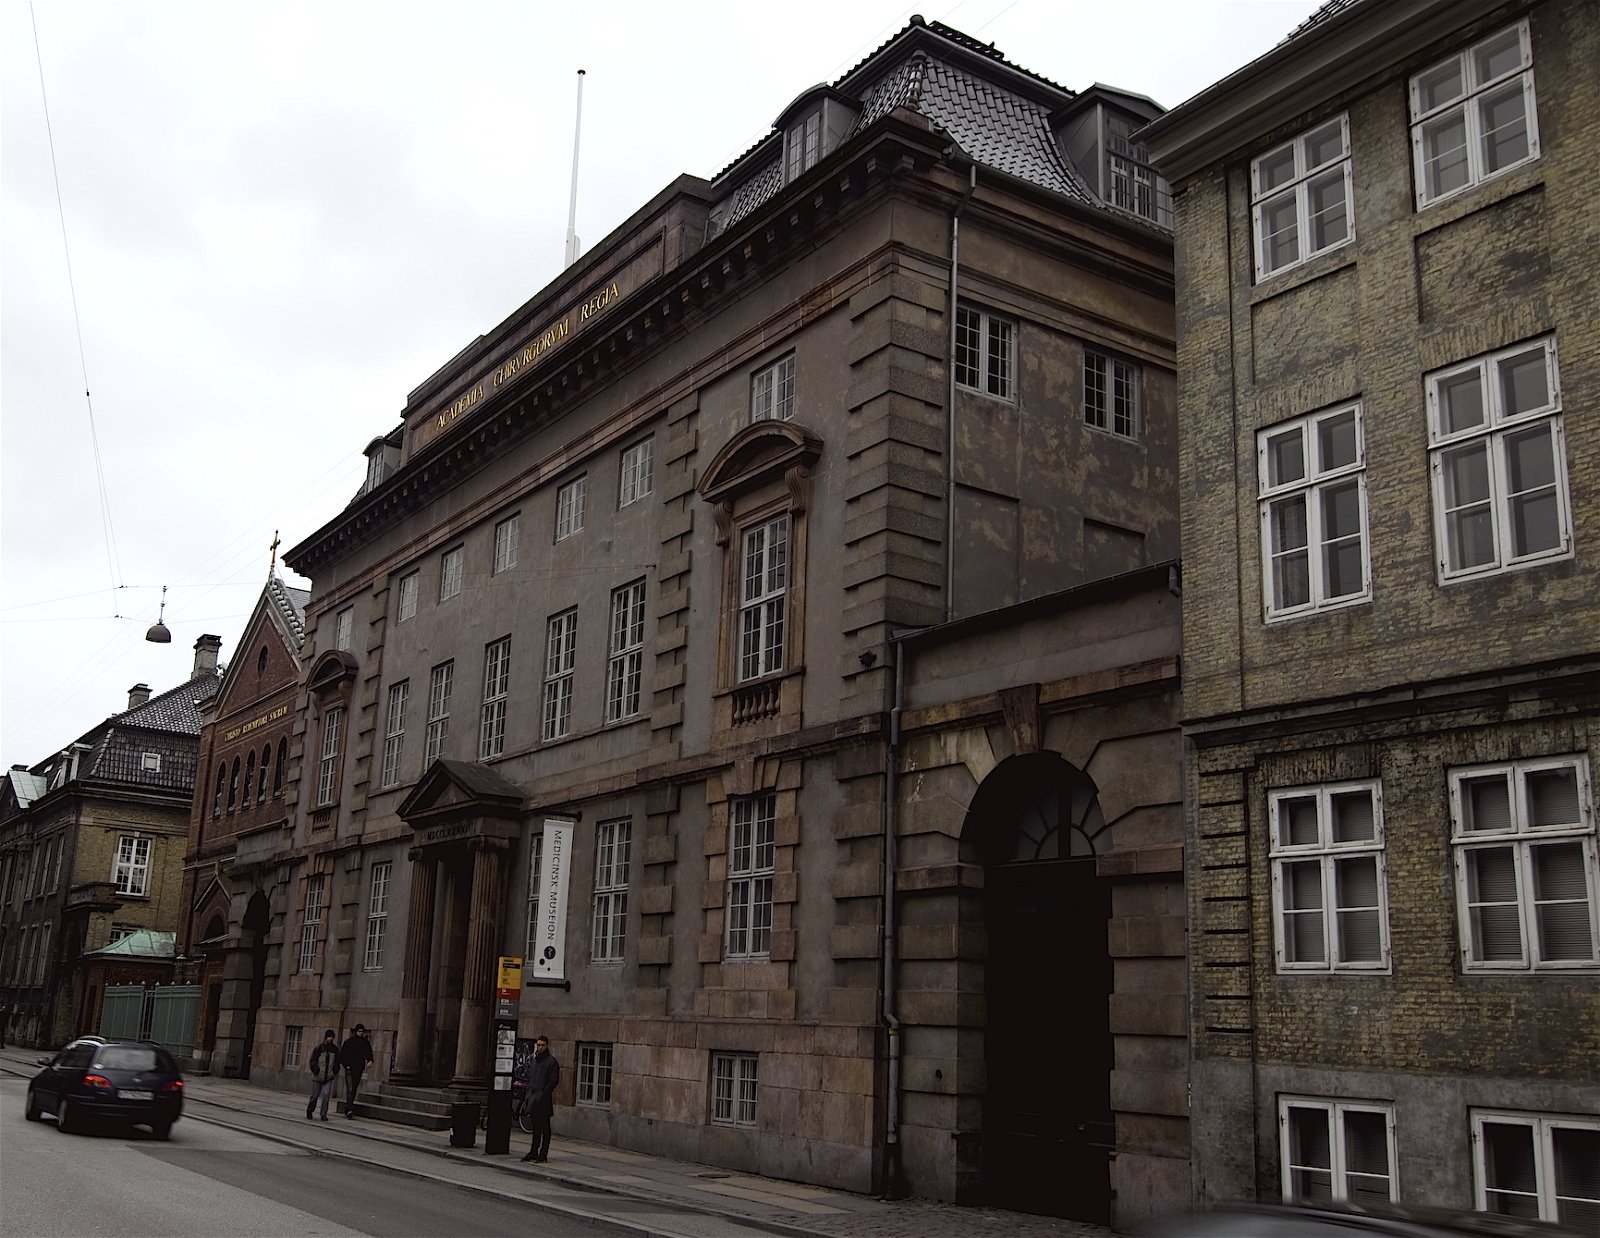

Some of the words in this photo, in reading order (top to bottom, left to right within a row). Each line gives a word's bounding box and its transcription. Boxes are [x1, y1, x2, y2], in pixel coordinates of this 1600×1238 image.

[437, 385, 484, 431] ACADEMIA
[493, 318, 569, 388] CHIRVRGORVM
[580, 282, 619, 323] REGIA
[551, 830, 562, 887] MEDICINSK
[547, 891, 558, 940] MUSEION
